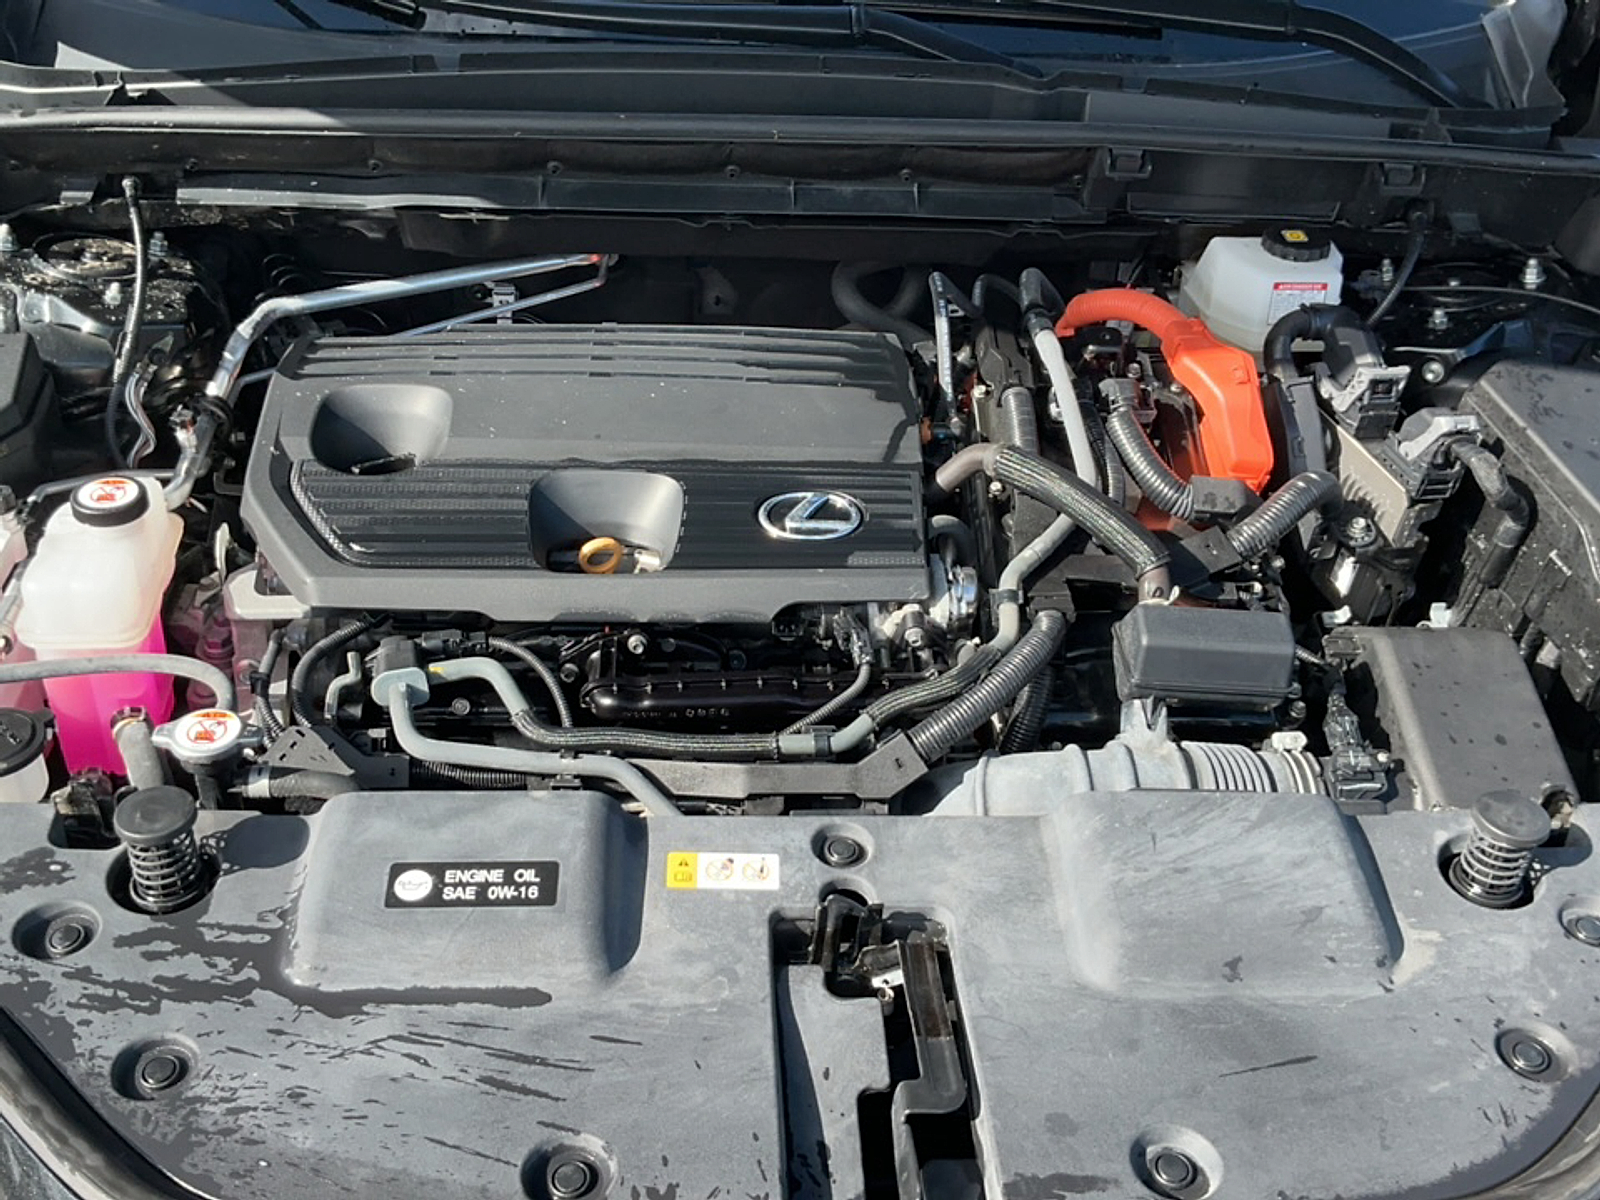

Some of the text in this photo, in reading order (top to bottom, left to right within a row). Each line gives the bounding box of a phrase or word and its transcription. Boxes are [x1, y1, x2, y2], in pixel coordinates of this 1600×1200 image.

[444, 869, 540, 883] ENGINE OIL
[442, 886, 539, 900] SAE 0W-16
